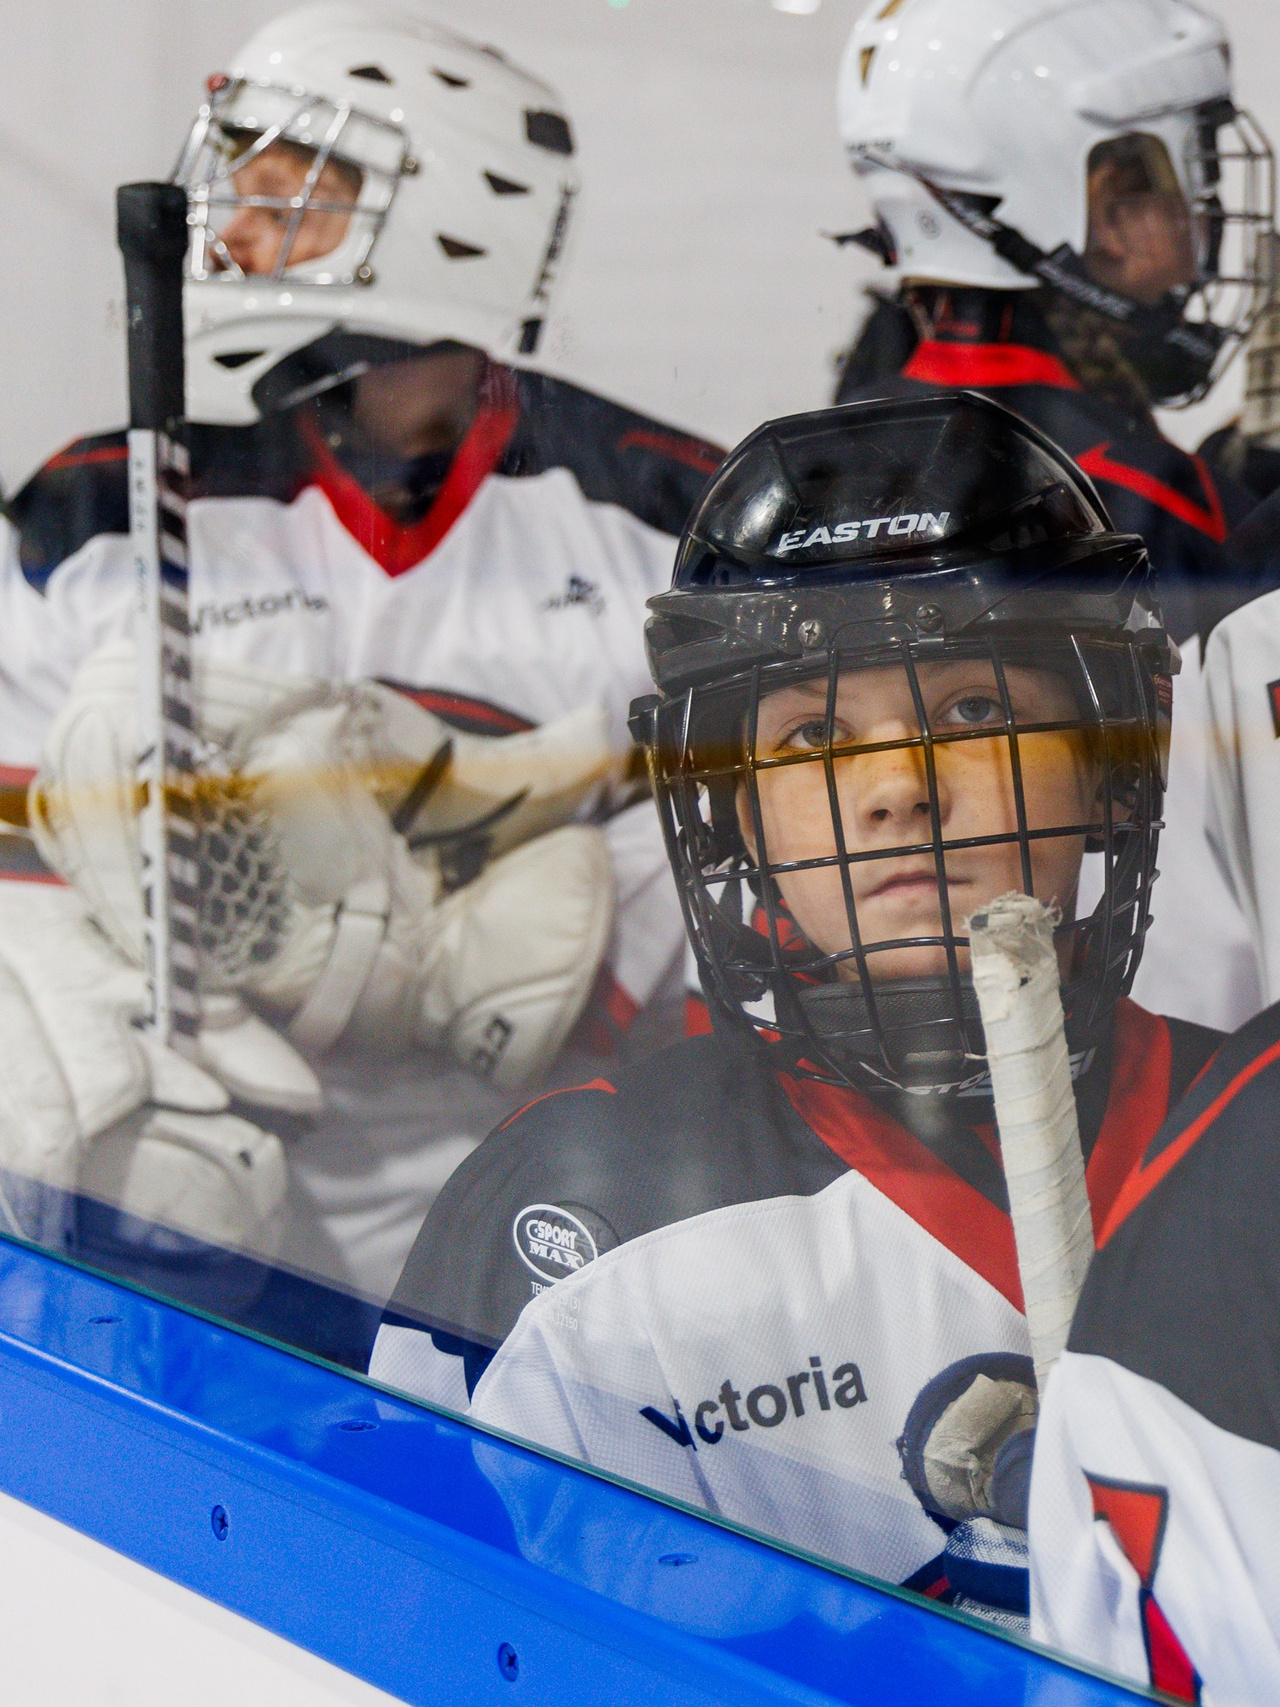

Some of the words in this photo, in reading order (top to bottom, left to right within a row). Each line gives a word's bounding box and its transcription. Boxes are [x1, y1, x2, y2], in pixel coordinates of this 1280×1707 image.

[777, 511, 950, 551] EASTON
[537, 1220, 578, 1250] SPORT
[529, 1240, 582, 1270] MAX
[639, 1355, 868, 1451] Vctoria
